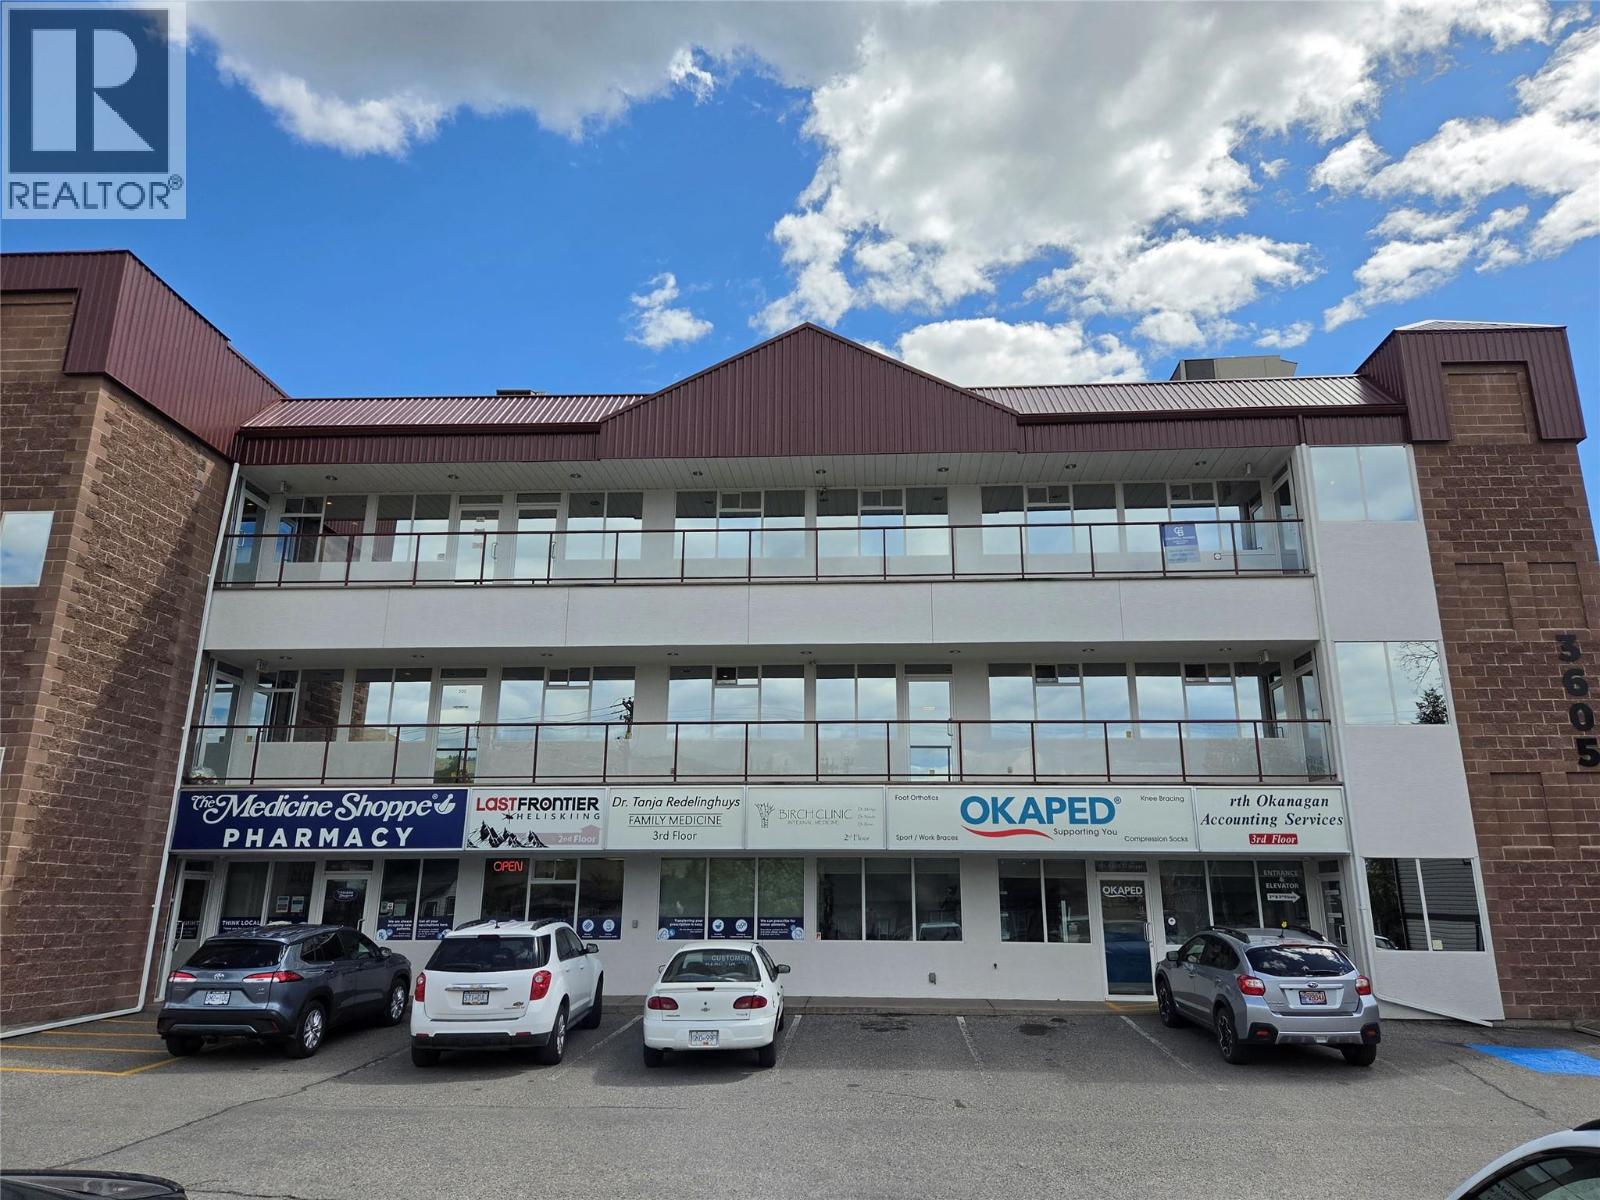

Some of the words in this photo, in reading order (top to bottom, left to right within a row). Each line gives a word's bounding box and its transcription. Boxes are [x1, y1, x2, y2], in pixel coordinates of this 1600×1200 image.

[1555, 634, 1600, 767] 3605
[191, 795, 216, 811] The
[612, 796, 628, 808] Dr.
[632, 796, 663, 809] Tanja
[666, 795, 741, 810] Redelinghuys
[1158, 795, 1185, 803] Bracing
[1230, 794, 1250, 807] rth
[1256, 794, 1330, 810] Okanagan
[203, 793, 333, 824] Medicine
[516, 812, 601, 821] HELISKIING
[779, 809, 814, 820] BIRCH
[815, 809, 853, 820] CLINIC
[1200, 812, 1278, 828] Accounting
[1284, 812, 1344, 826] Services
[629, 815, 666, 826] FAMILY
[668, 815, 722, 826] MEDICINE
[223, 827, 414, 848] PHARMACY
[652, 830, 670, 841] 3rd
[673, 830, 698, 841] Floor
[1053, 827, 1100, 838] Supporting
[1101, 827, 1118, 836] You
[558, 836, 572, 844] 2nd
[573, 834, 597, 844] Floor
[896, 834, 913, 843] Sport
[919, 834, 936, 842] Work
[937, 834, 959, 842] Braces
[1124, 835, 1168, 844] Compression
[1169, 835, 1189, 843] Socks
[1250, 834, 1267, 844] 3rd
[1271, 834, 1298, 844] Floor
[493, 860, 524, 872] OPEN
[1263, 869, 1299, 877] ENTRANCE
[1102, 885, 1143, 895] OKAPED
